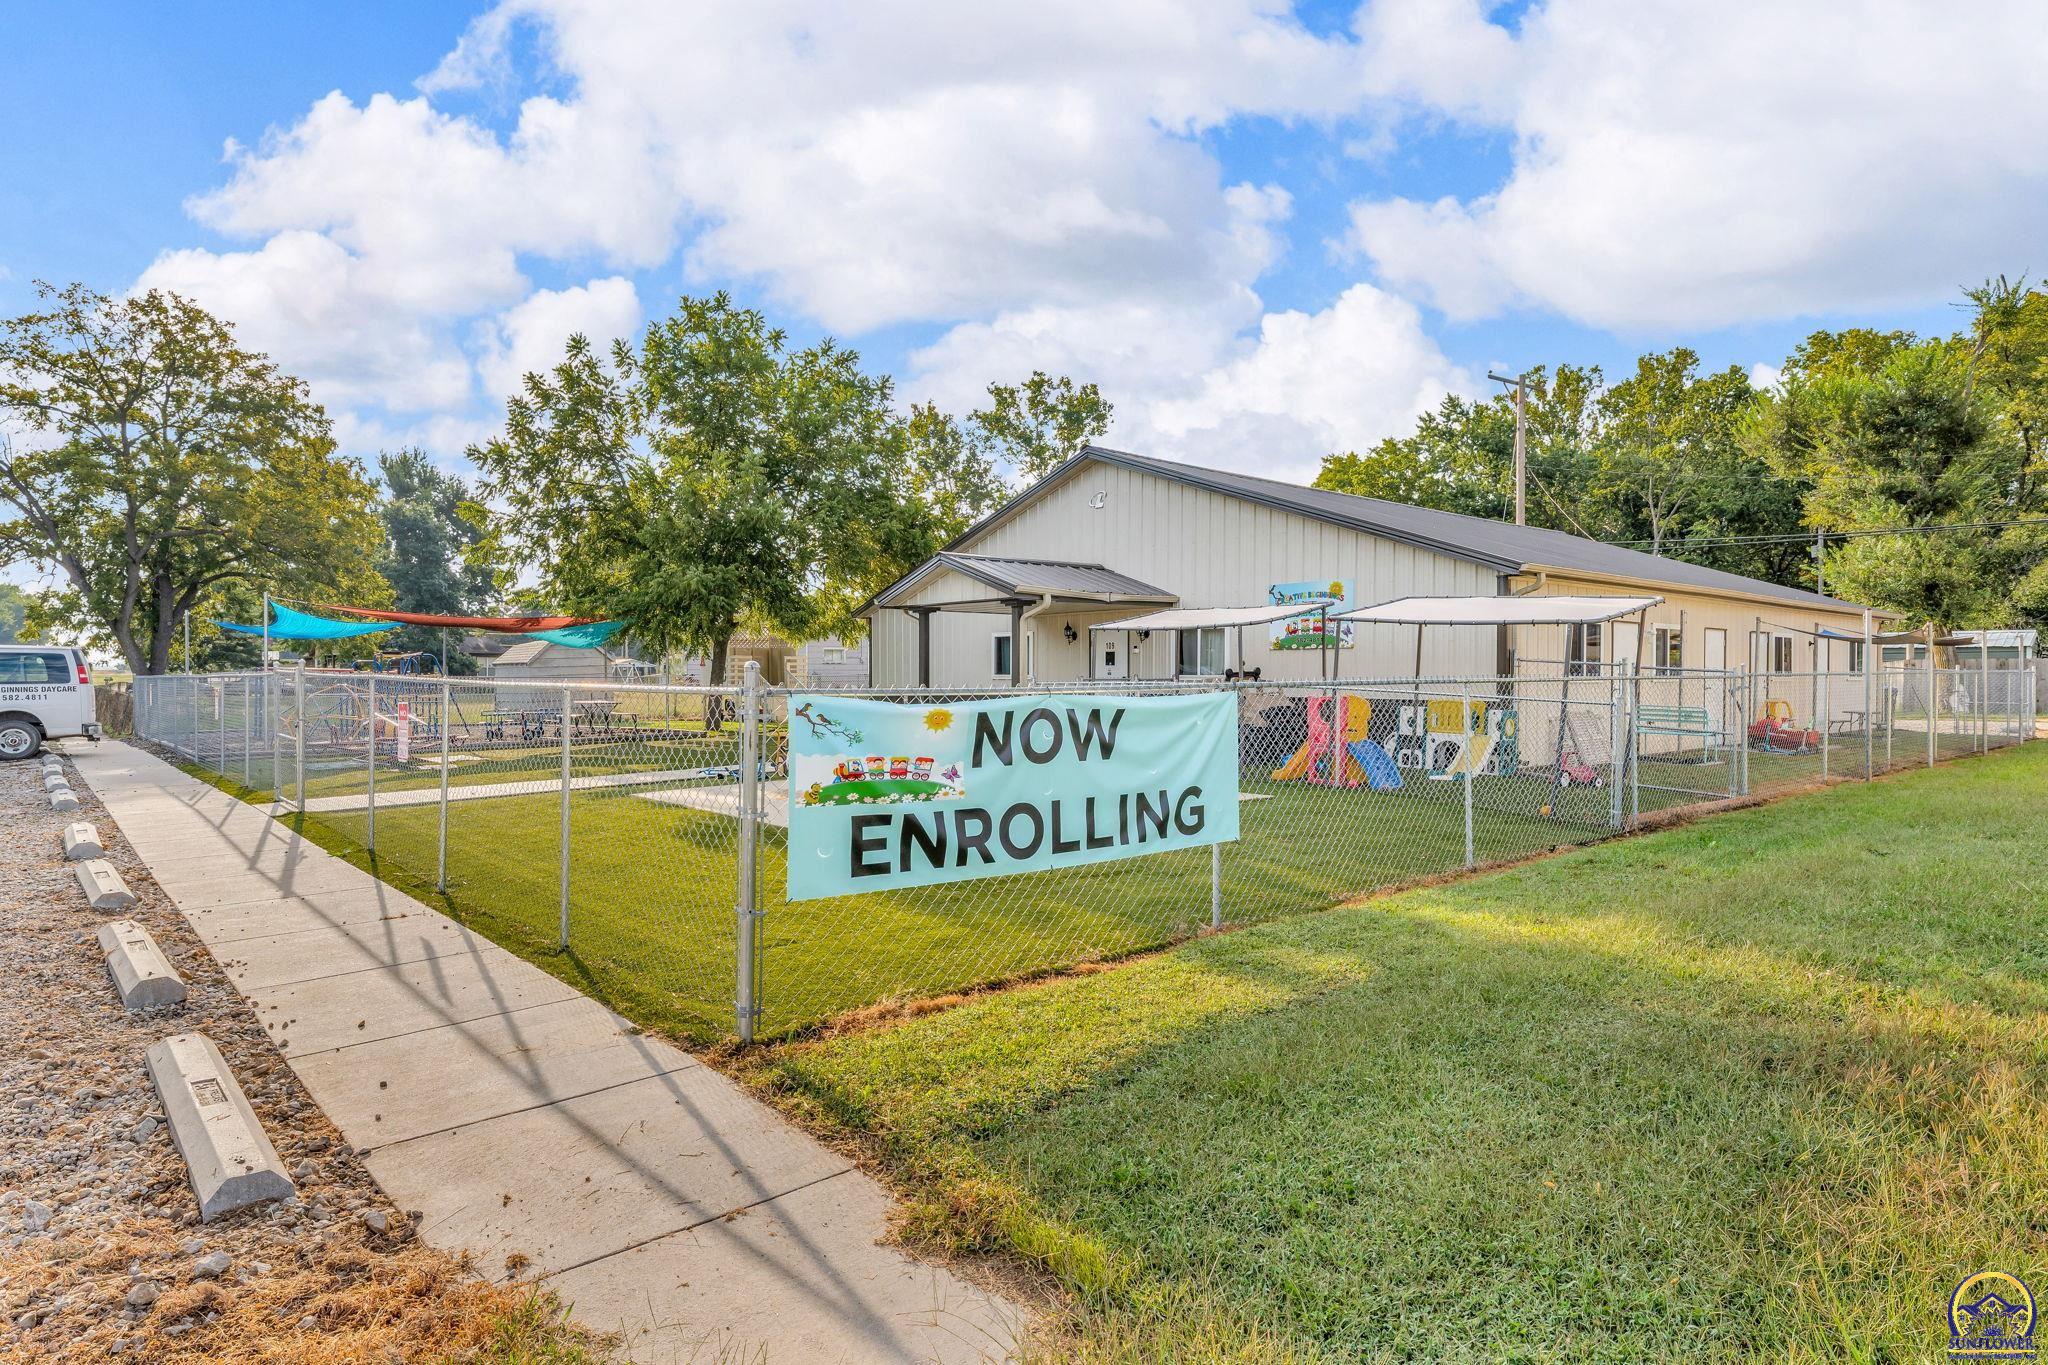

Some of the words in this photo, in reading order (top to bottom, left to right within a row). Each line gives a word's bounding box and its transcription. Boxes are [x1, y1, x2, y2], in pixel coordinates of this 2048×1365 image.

[41, 685, 78, 693] DAYCARE
[971, 707, 1126, 769] NOW
[850, 785, 1205, 879] ENROLLING
